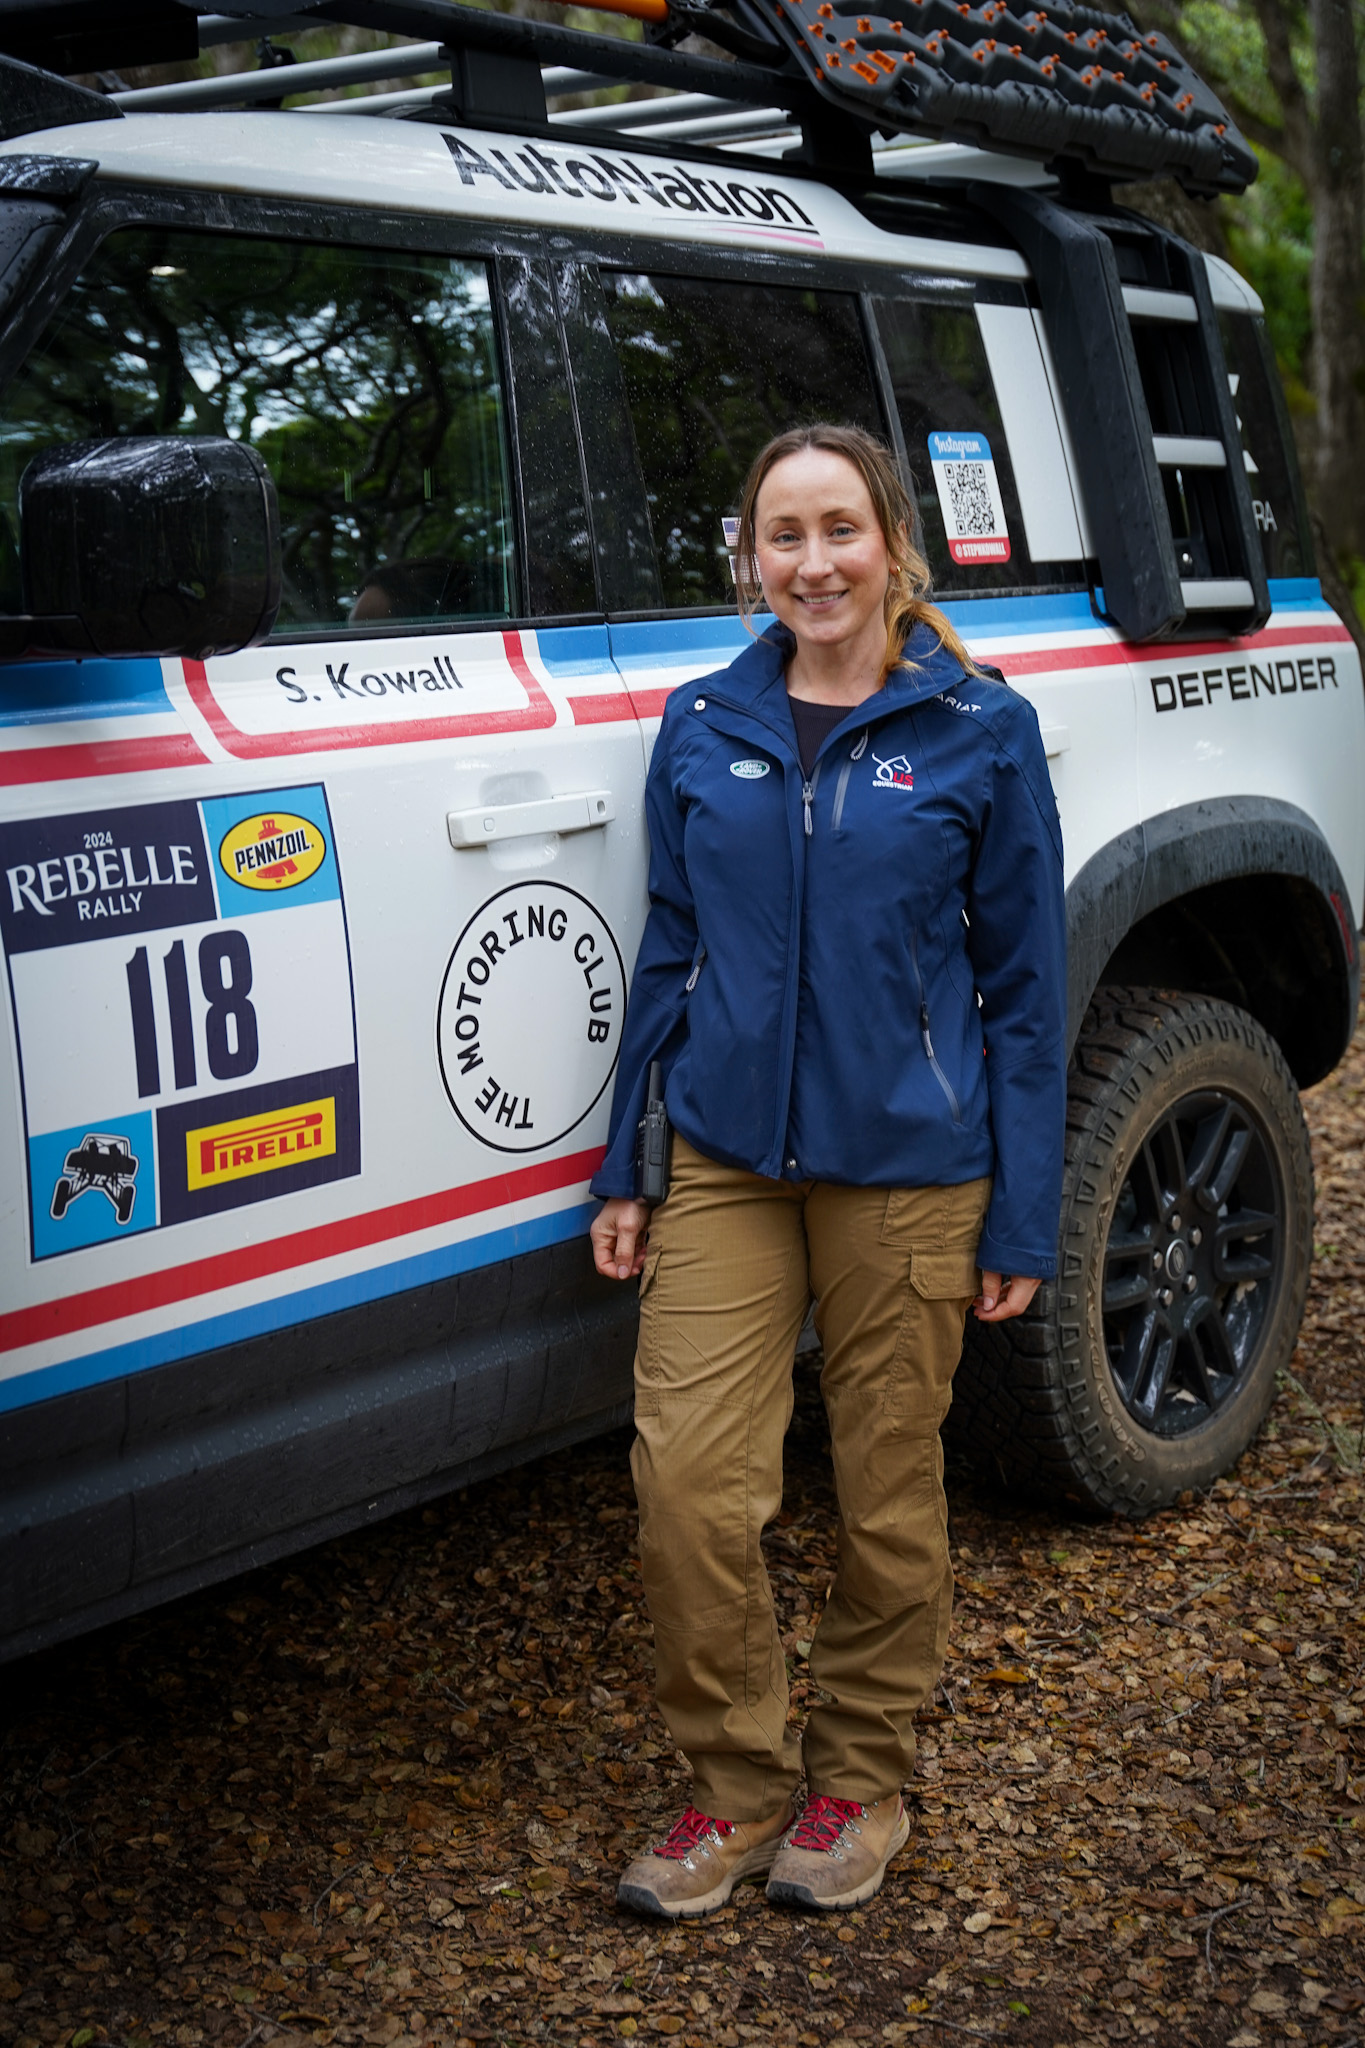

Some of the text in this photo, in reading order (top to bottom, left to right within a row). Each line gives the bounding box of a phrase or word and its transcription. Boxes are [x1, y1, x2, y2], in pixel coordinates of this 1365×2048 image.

[439, 132, 814, 226] AutoNation
[934, 435, 982, 459] Instagram
[275, 655, 464, 703] S. Kowall
[1150, 656, 1339, 713] DEFENDER
[872, 780, 914, 792] EQUESTRIAN
[893, 771, 914, 786] US
[83, 831, 114, 850] 2024
[234, 828, 310, 874] PENNZOIL
[6, 845, 199, 916] REBELLE
[77, 891, 143, 921] RALLY
[126, 929, 259, 1099] 118
[455, 905, 612, 1130] THE MOTORING CLUB
[200, 1112, 323, 1175] PIRELLI
